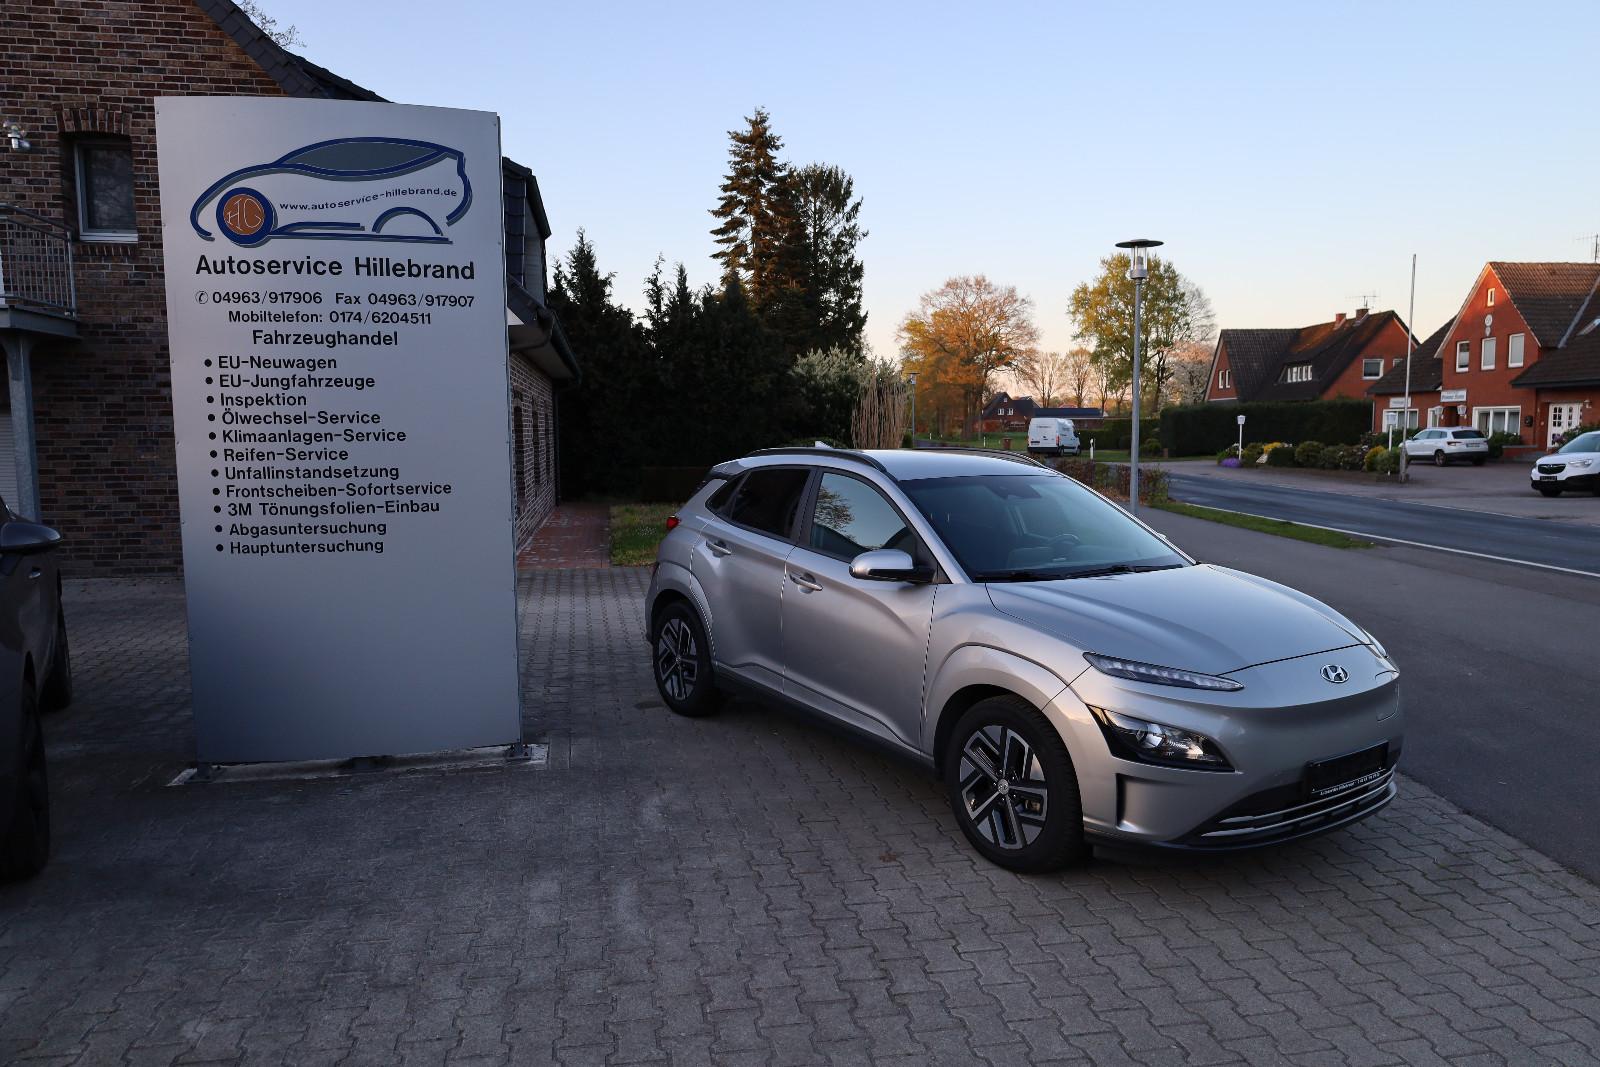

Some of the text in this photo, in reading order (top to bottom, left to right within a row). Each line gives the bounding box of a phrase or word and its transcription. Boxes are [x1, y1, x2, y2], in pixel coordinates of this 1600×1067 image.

[280, 188, 458, 210] www.autoservice-hillebrand.de
[196, 255, 474, 279] Autoservice Hillebrand
[213, 291, 474, 307] 04963/917906 Fax 04963/917907
[229, 311, 430, 324] Mobiltelefon: 0174/6204511
[253, 330, 397, 348] Fahrzeughandel
[219, 356, 336, 371] EU-Neuwagen
[220, 374, 375, 390] EU-Jungfahrzeuge
[221, 393, 306, 408] Inspektion
[222, 408, 380, 424] Ölwechsel-Service
[223, 429, 406, 445] Klimaanlagen-Service
[224, 448, 348, 461] Reifen-Service
[225, 466, 399, 480] Unfallinstandsetzung
[227, 482, 451, 497] Frontscheiben-Sofortservice
[228, 500, 439, 517] 3M Tönungsfolien-Einbau
[230, 522, 386, 538] Abgasuntersuchung
[231, 540, 383, 556] Hauptuntersuchung
